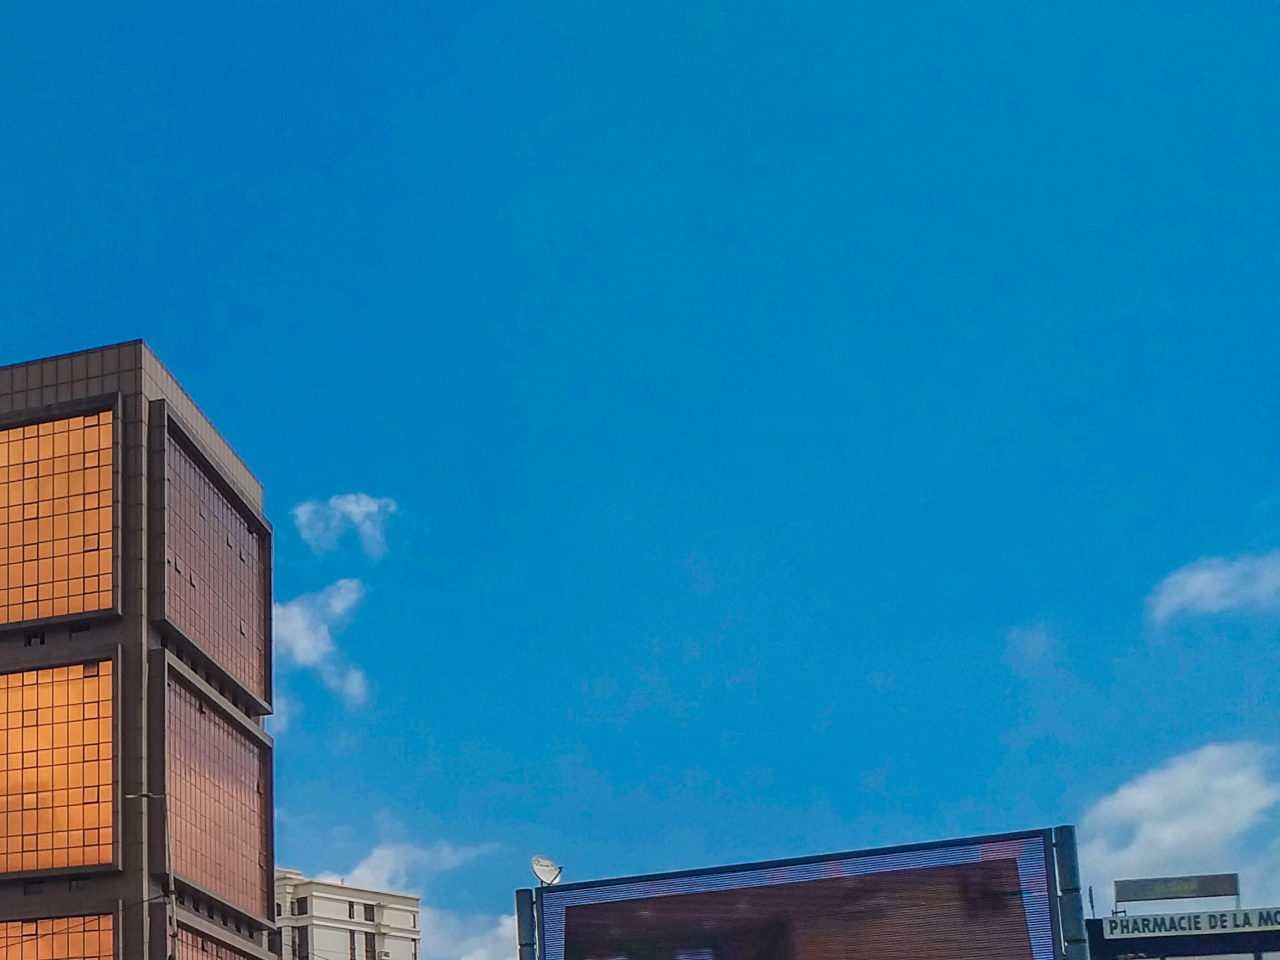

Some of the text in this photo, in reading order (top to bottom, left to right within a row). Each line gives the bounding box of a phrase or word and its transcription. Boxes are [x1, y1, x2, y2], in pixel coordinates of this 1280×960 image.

[1109, 914, 1202, 935] PHARMACIE
[1208, 913, 1228, 929] DE
[1232, 912, 1253, 928] LA
